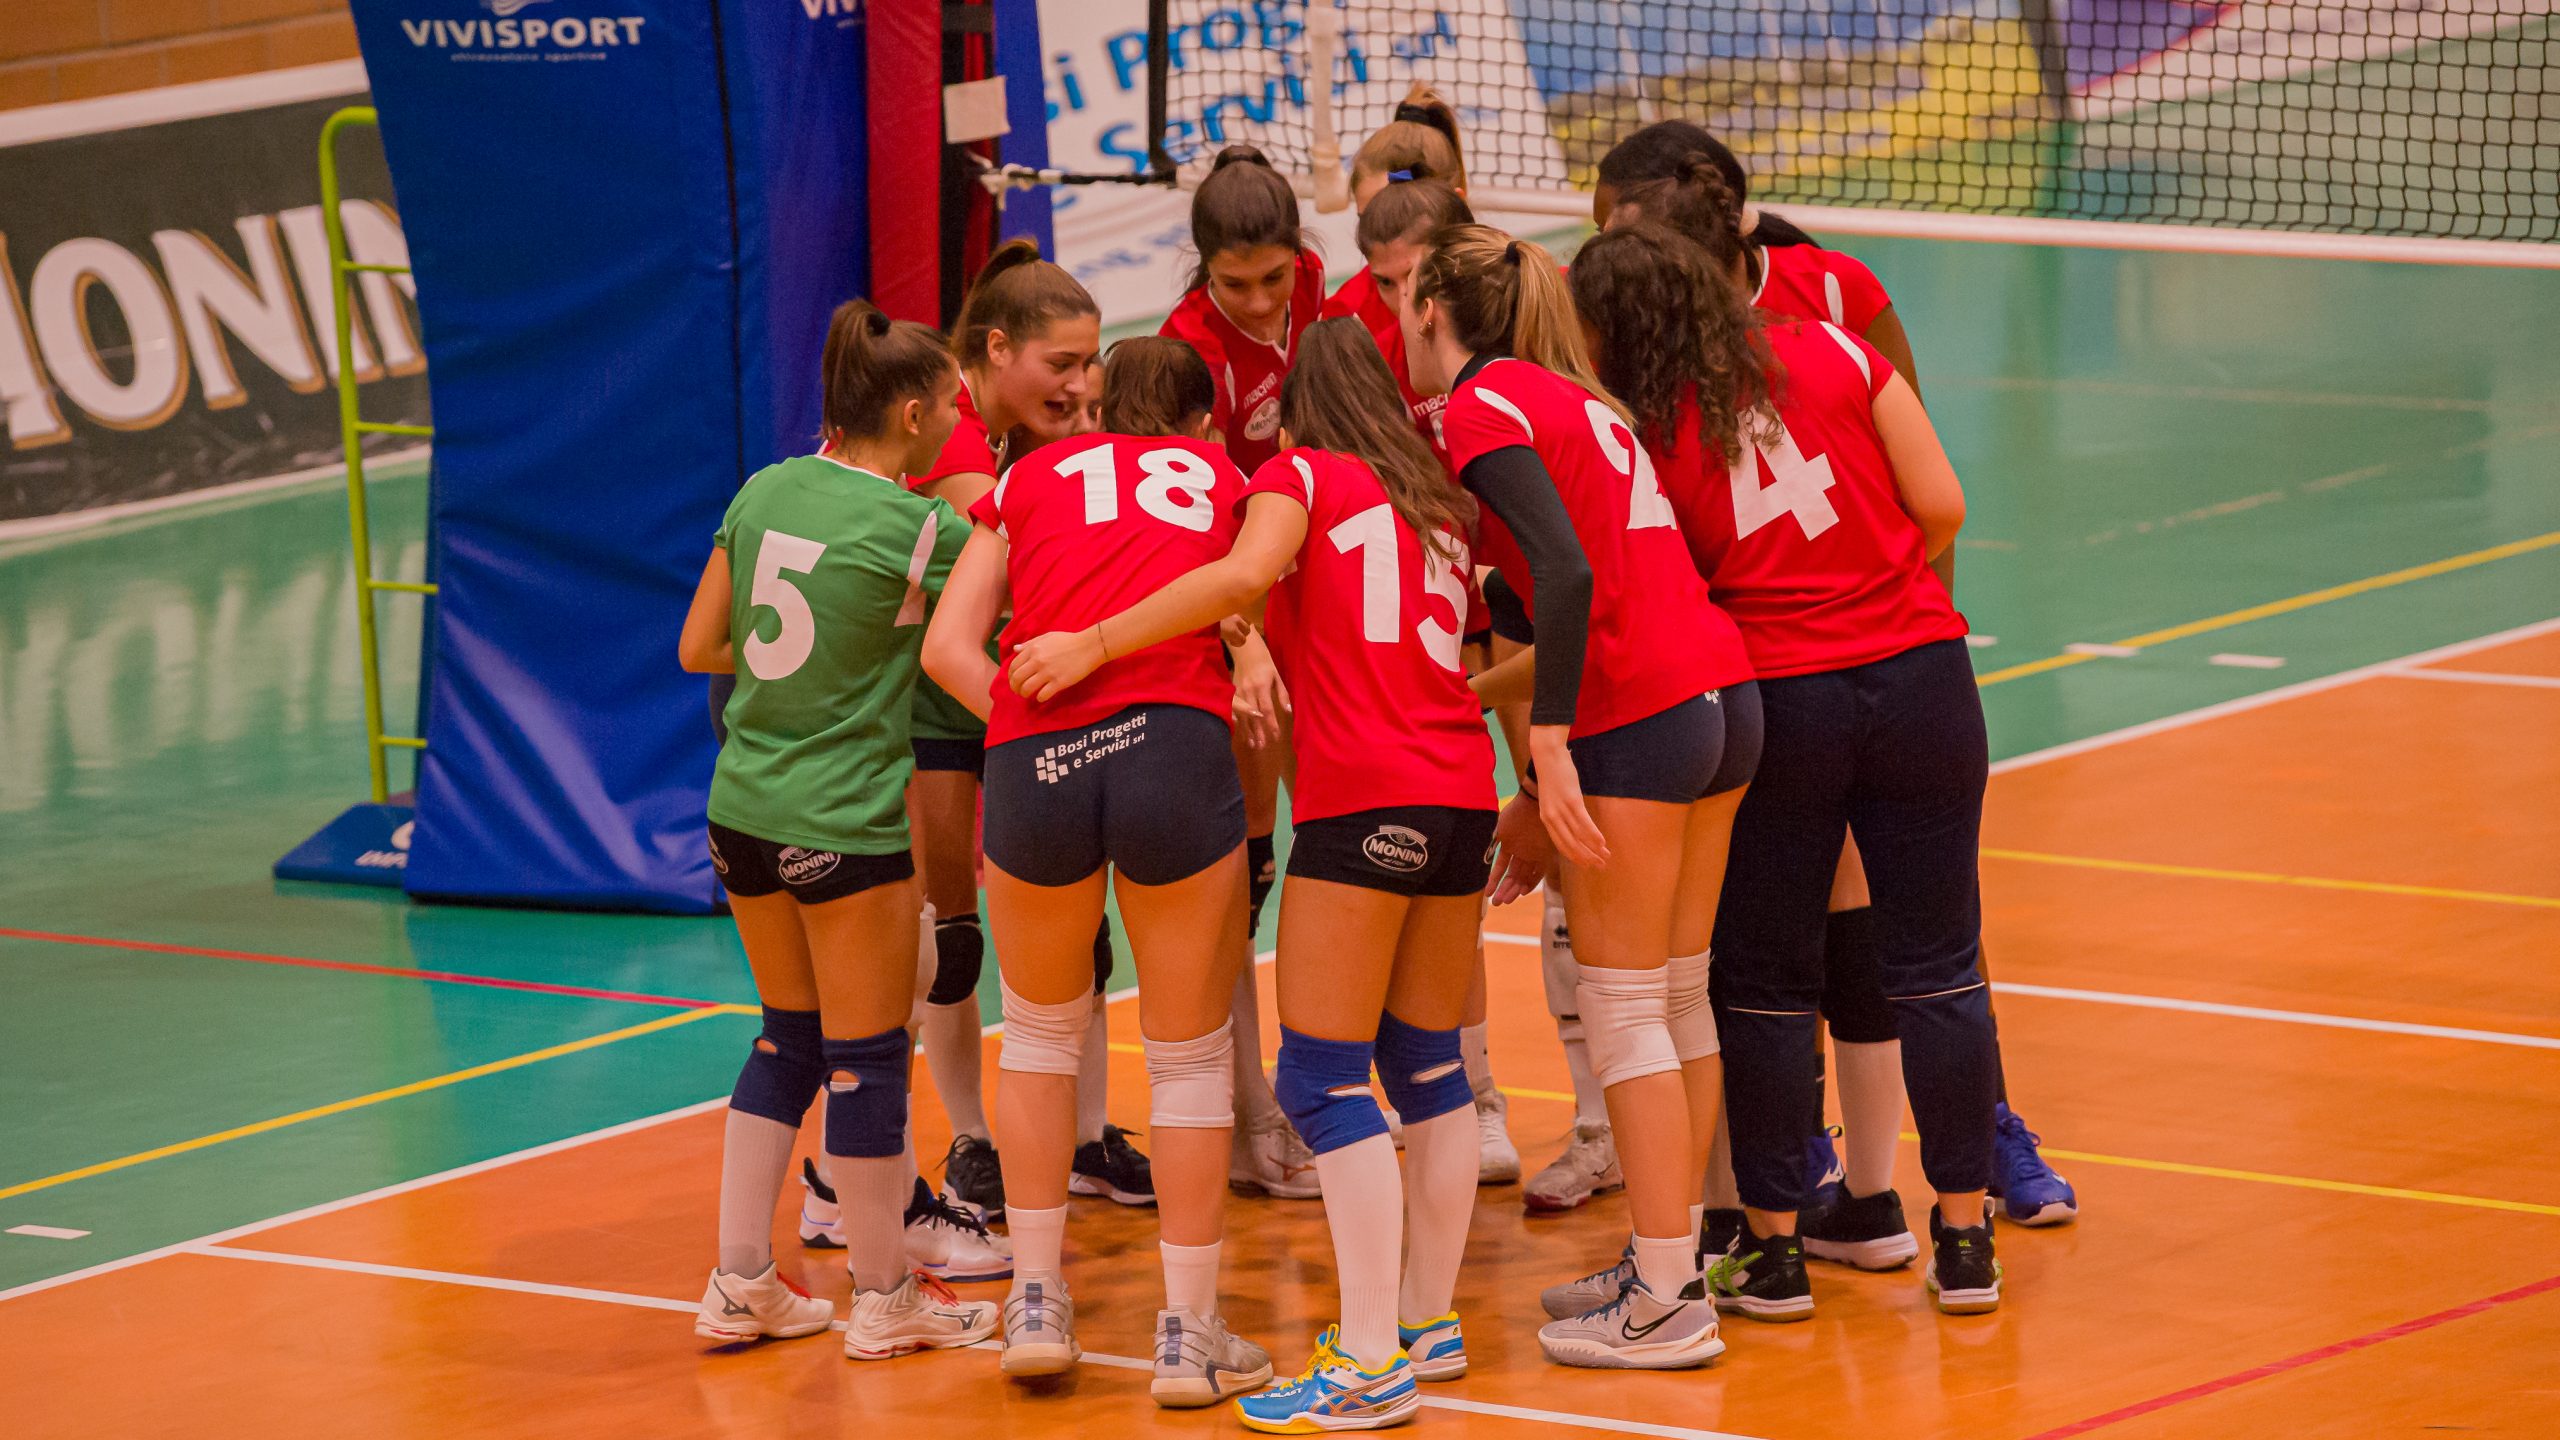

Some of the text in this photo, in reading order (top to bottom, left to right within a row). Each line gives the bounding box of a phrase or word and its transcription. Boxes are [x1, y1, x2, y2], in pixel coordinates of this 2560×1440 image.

[400, 17, 646, 48] VIVISPORT
[1053, 443, 1216, 532] 18
[1729, 401, 1839, 542] 4
[743, 528, 827, 681] 5
[1326, 502, 1470, 673] 15
[1057, 713, 1146, 757] Bosi Progetti
[1073, 732, 1145, 769] e Servizi srl
[781, 852, 836, 879] MONINI
[1368, 838, 1424, 865] MONINI
